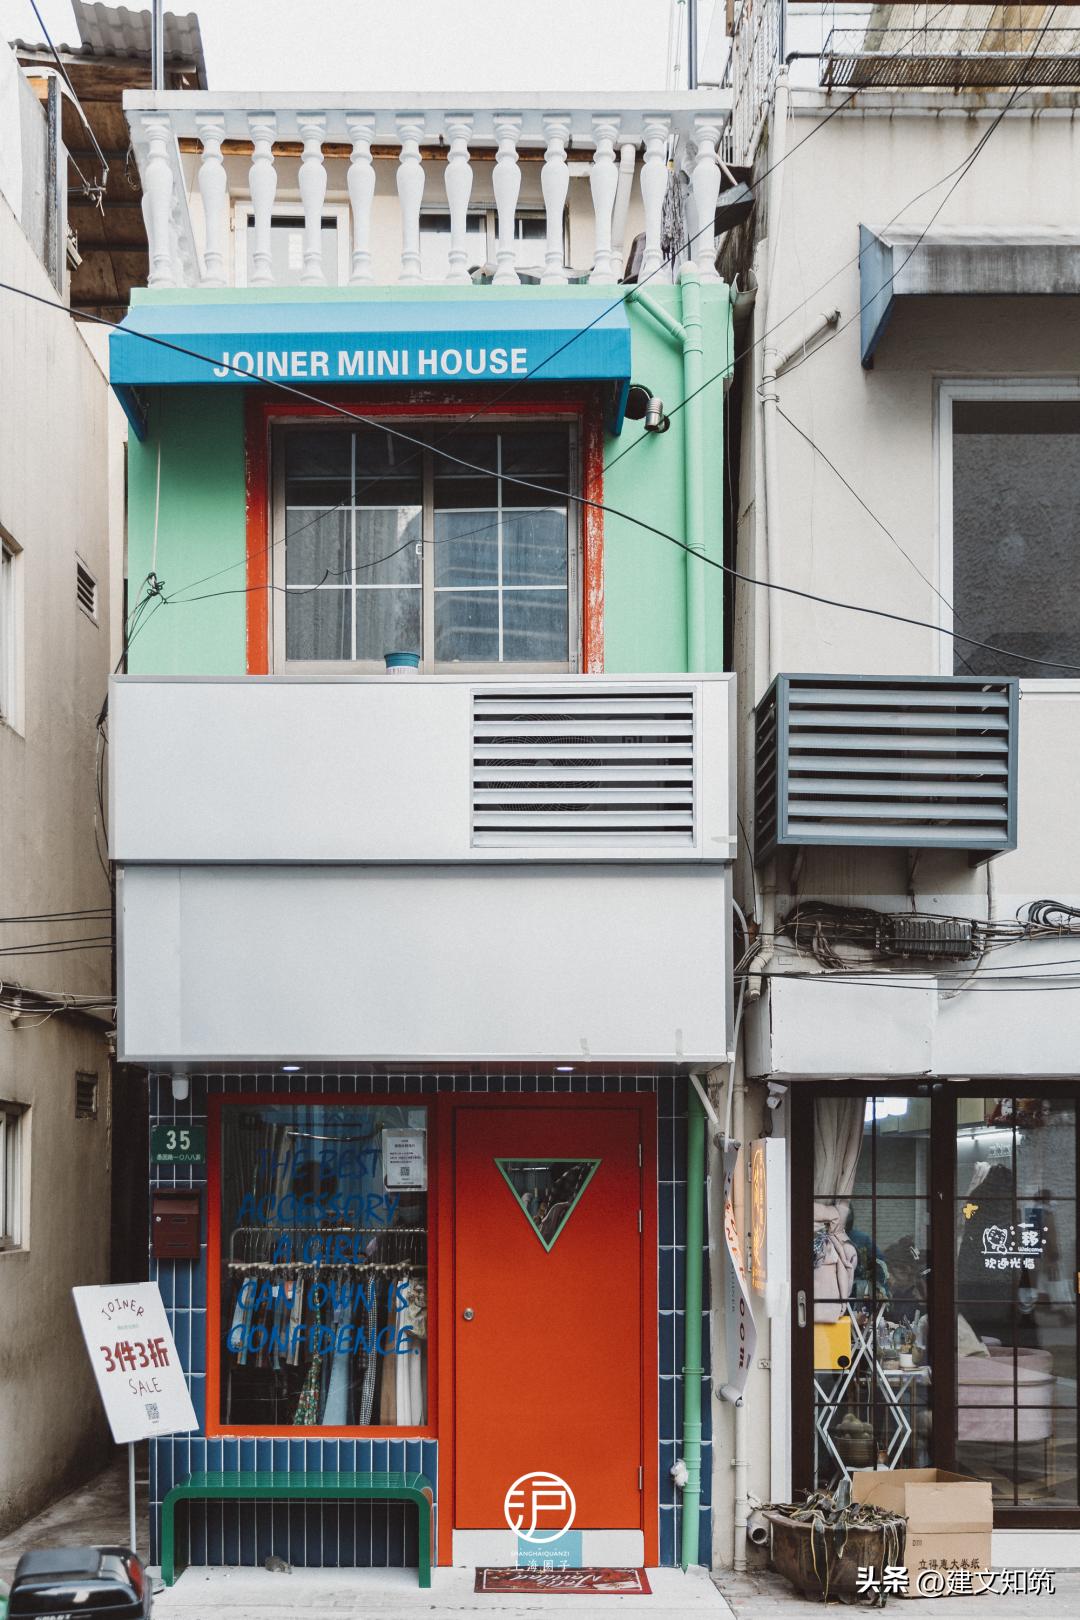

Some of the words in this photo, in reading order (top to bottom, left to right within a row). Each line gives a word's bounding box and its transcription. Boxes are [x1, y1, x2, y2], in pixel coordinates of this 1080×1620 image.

[213, 351, 330, 378] JOINER
[338, 350, 408, 376] MINI
[418, 348, 528, 375] HOUSE
[166, 1130, 191, 1150] 35
[256, 1148, 305, 1178] THE
[319, 1149, 383, 1178] BEST
[237, 1192, 399, 1225] ACCESSORY
[273, 1230, 291, 1265] A
[303, 1231, 367, 1268] GIRL
[984, 1257, 1035, 1270] 欢迎光临
[101, 1298, 145, 1321] JOINER
[238, 1280, 297, 1312] CAN
[307, 1279, 376, 1312] OWN
[387, 1280, 410, 1312] IS
[100, 1337, 170, 1373] 3件3折
[128, 1377, 163, 1397] SALE
